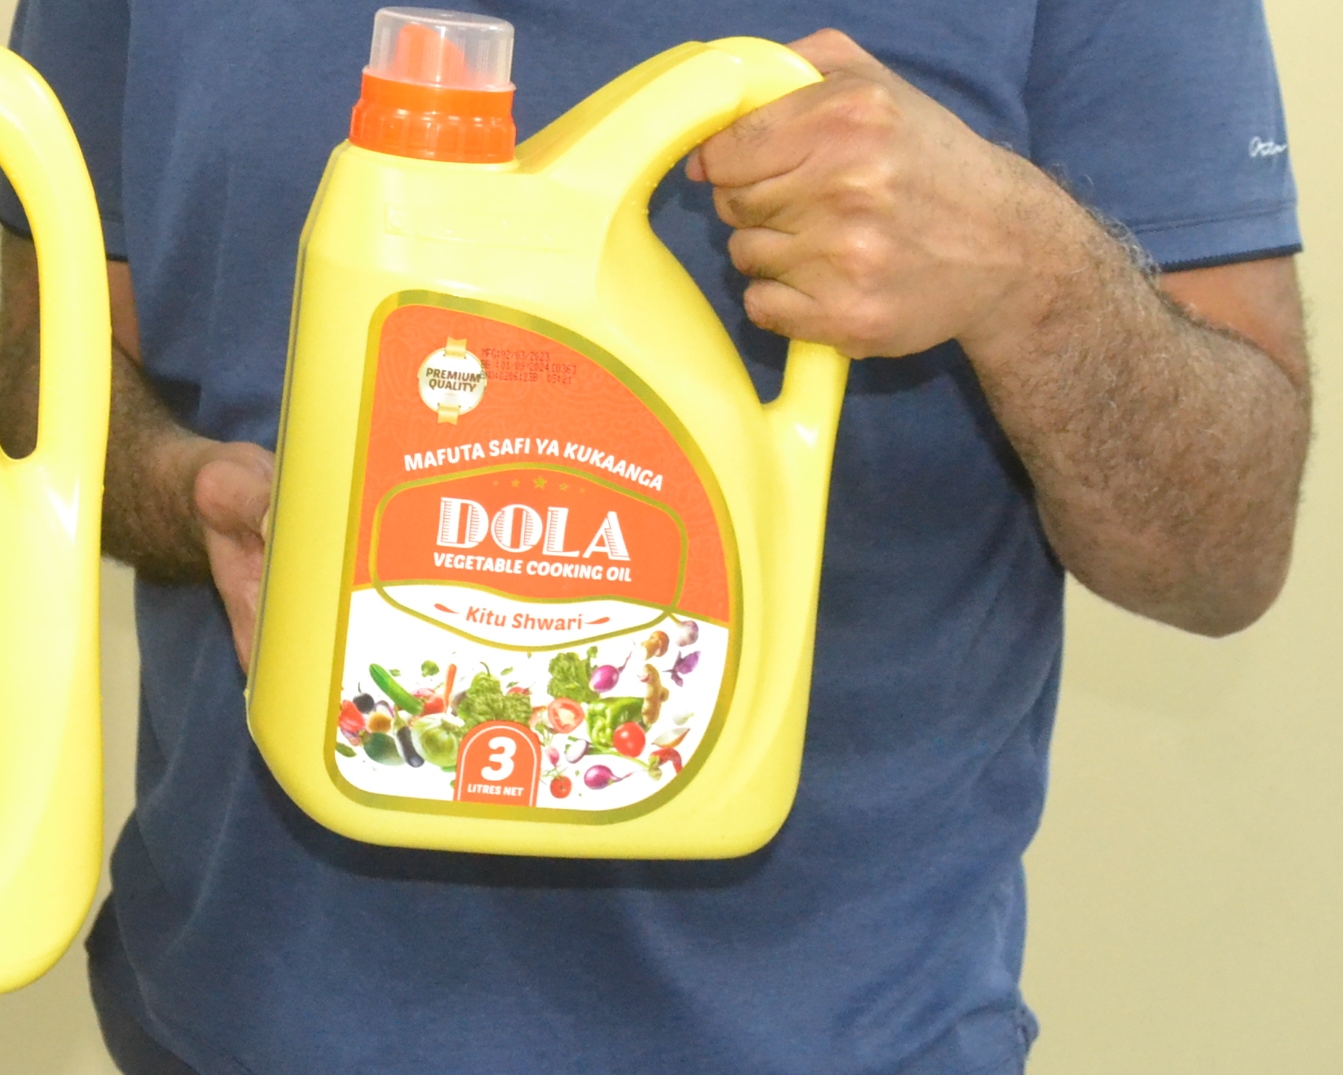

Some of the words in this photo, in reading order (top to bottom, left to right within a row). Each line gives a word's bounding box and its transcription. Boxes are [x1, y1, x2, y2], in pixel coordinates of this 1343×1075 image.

[425, 367, 481, 383] PREMIUM
[428, 379, 477, 393] QUALITY
[403, 442, 486, 472] MAFUTA
[488, 437, 531, 457] SAFI
[535, 437, 560, 457] YA
[563, 441, 664, 492] KUKAANGA
[436, 496, 632, 562] DOLA
[433, 552, 524, 575] VEGETABLE
[525, 560, 604, 581] COOKING
[606, 566, 633, 583] OIL
[465, 605, 507, 628] Kitu
[511, 612, 584, 631] Shwari
[480, 736, 517, 782] 3
[467, 783, 502, 795] LITRES
[502, 786, 524, 798] NET
